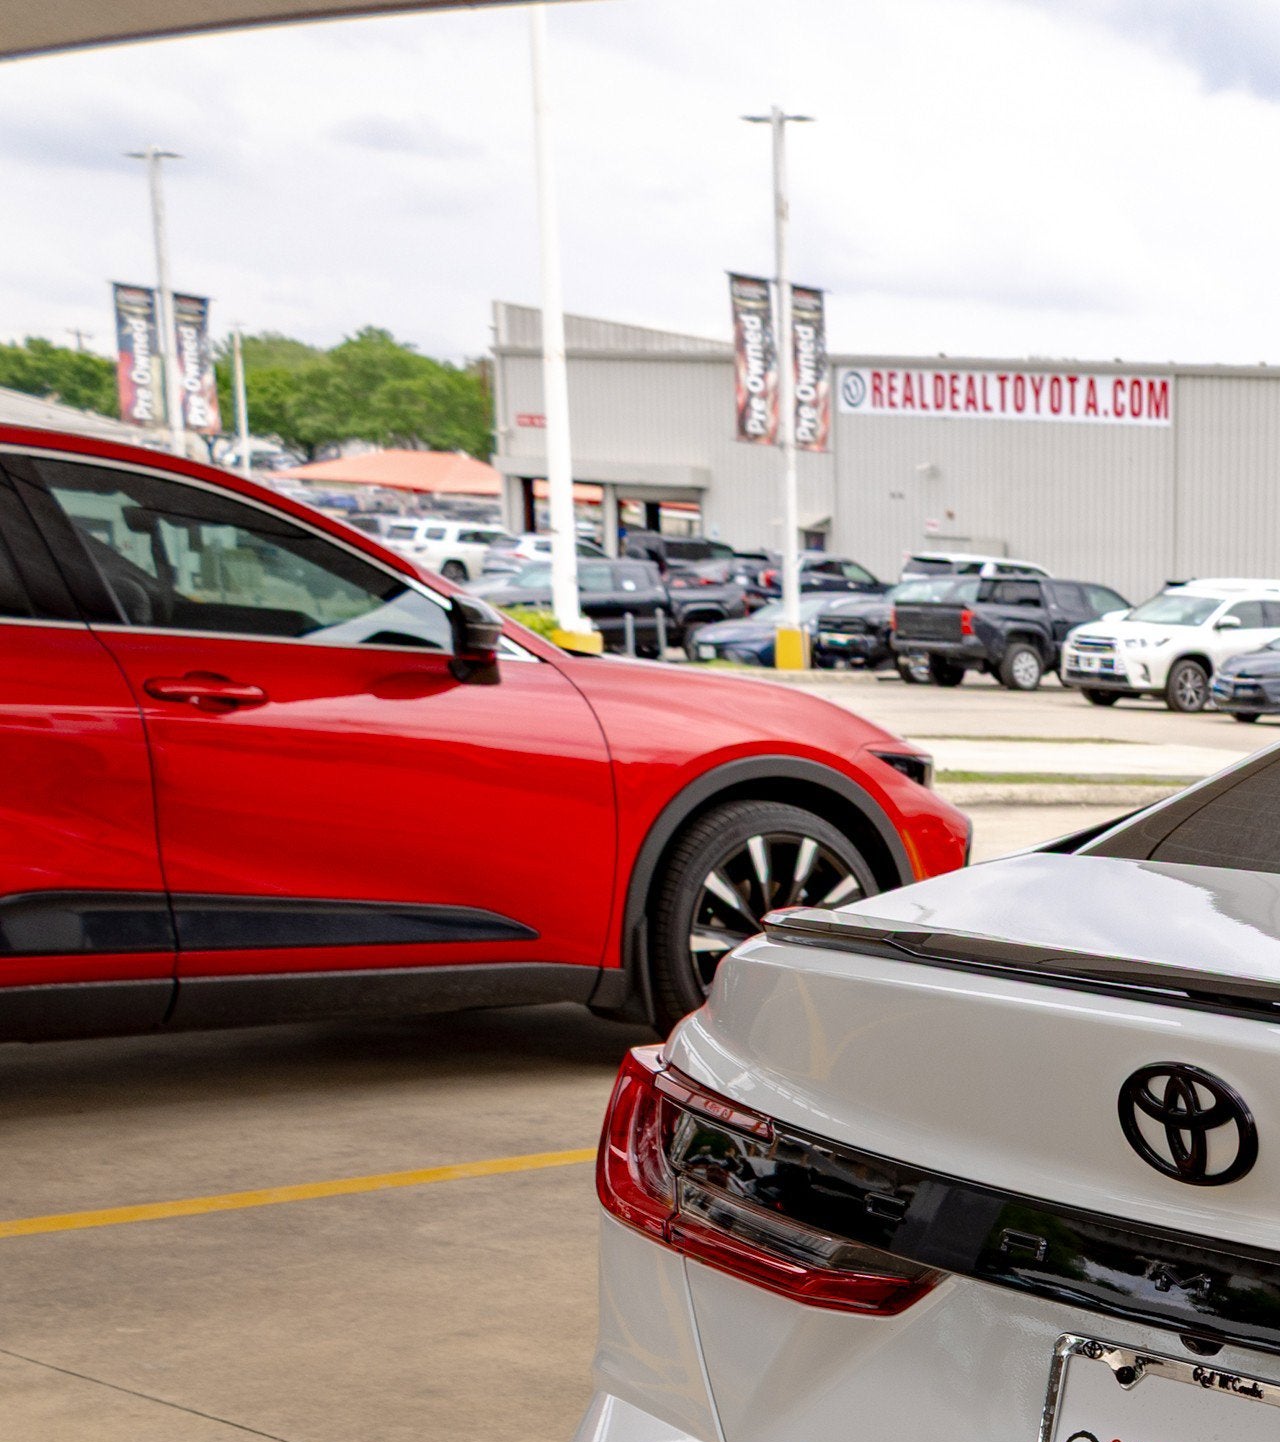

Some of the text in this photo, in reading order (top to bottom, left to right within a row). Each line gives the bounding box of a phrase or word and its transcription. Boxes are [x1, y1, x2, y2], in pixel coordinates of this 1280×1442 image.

[740, 314, 766, 394] Owned
[794, 324, 816, 401] Owned
[746, 396, 767, 435] Pre
[871, 371, 1169, 419] REALDEALTOYOTA.COM
[796, 405, 817, 442] Pre
